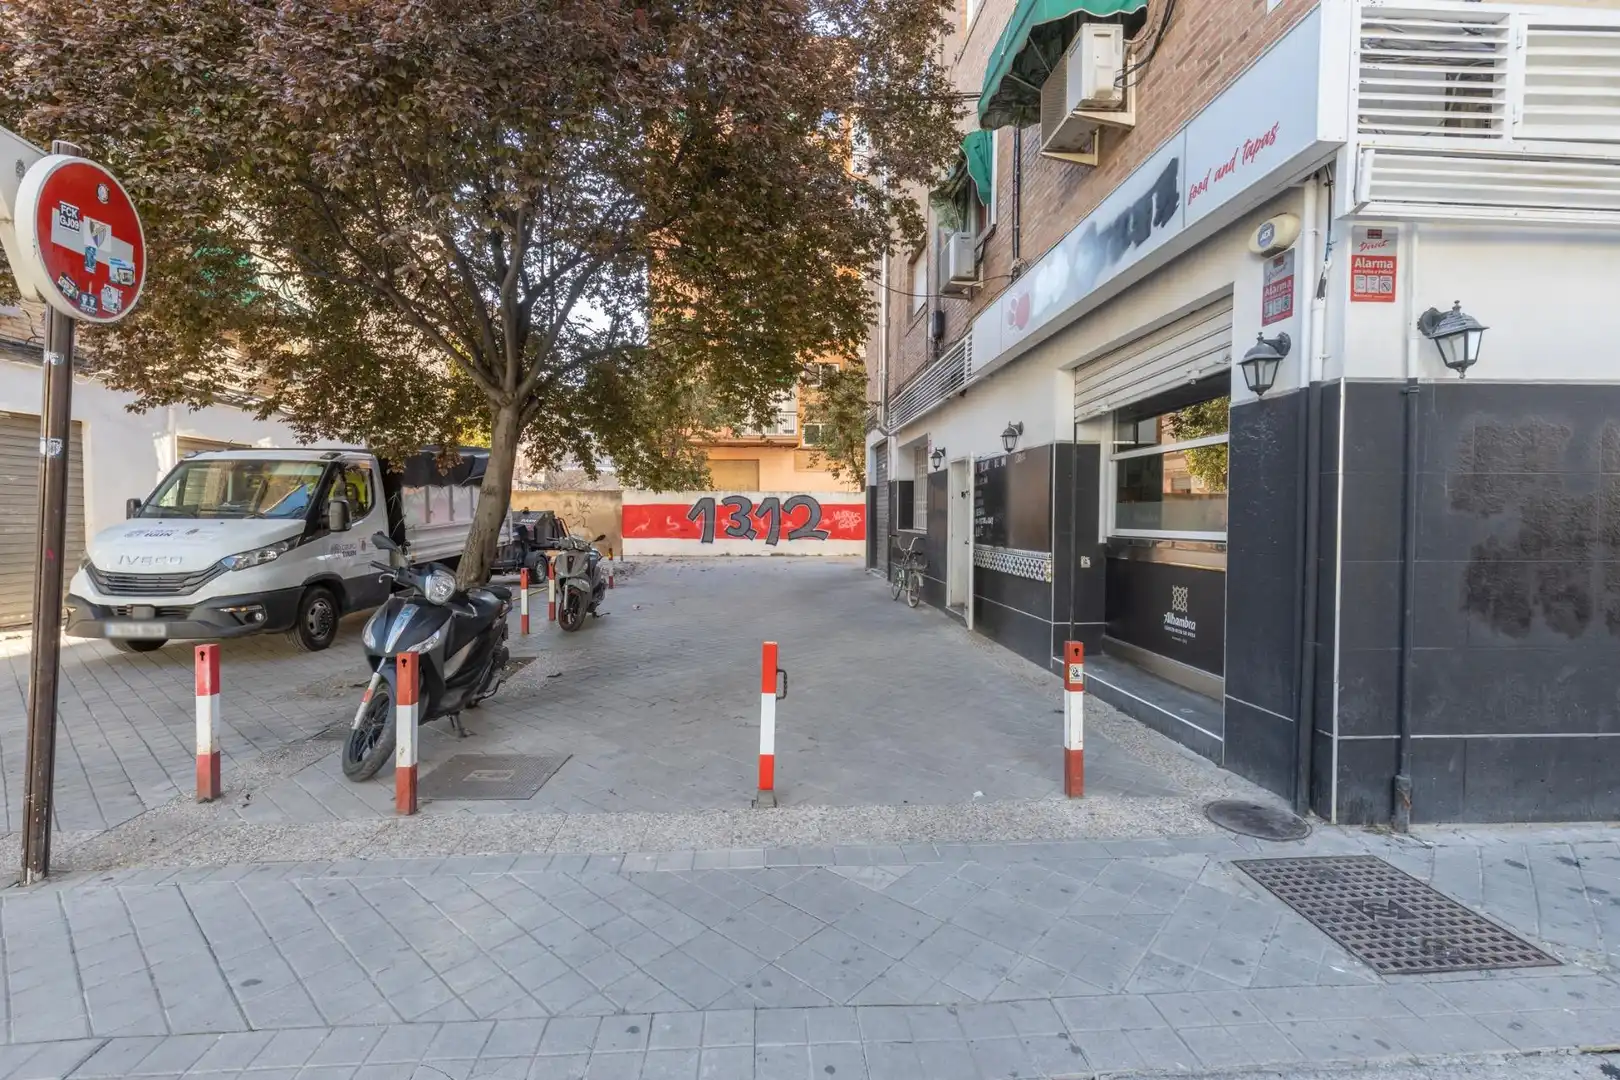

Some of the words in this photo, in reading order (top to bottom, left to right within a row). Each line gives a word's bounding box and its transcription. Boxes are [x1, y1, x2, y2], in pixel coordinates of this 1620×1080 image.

[1188, 168, 1212, 206] food
[1214, 147, 1239, 182] and
[1242, 121, 1279, 165] tapas
[61, 205, 78, 219] FCK
[1354, 257, 1393, 269] Alarma
[687, 494, 830, 546] 1312
[118, 554, 184, 567] IVECO
[1163, 611, 1196, 631] Alhambra
